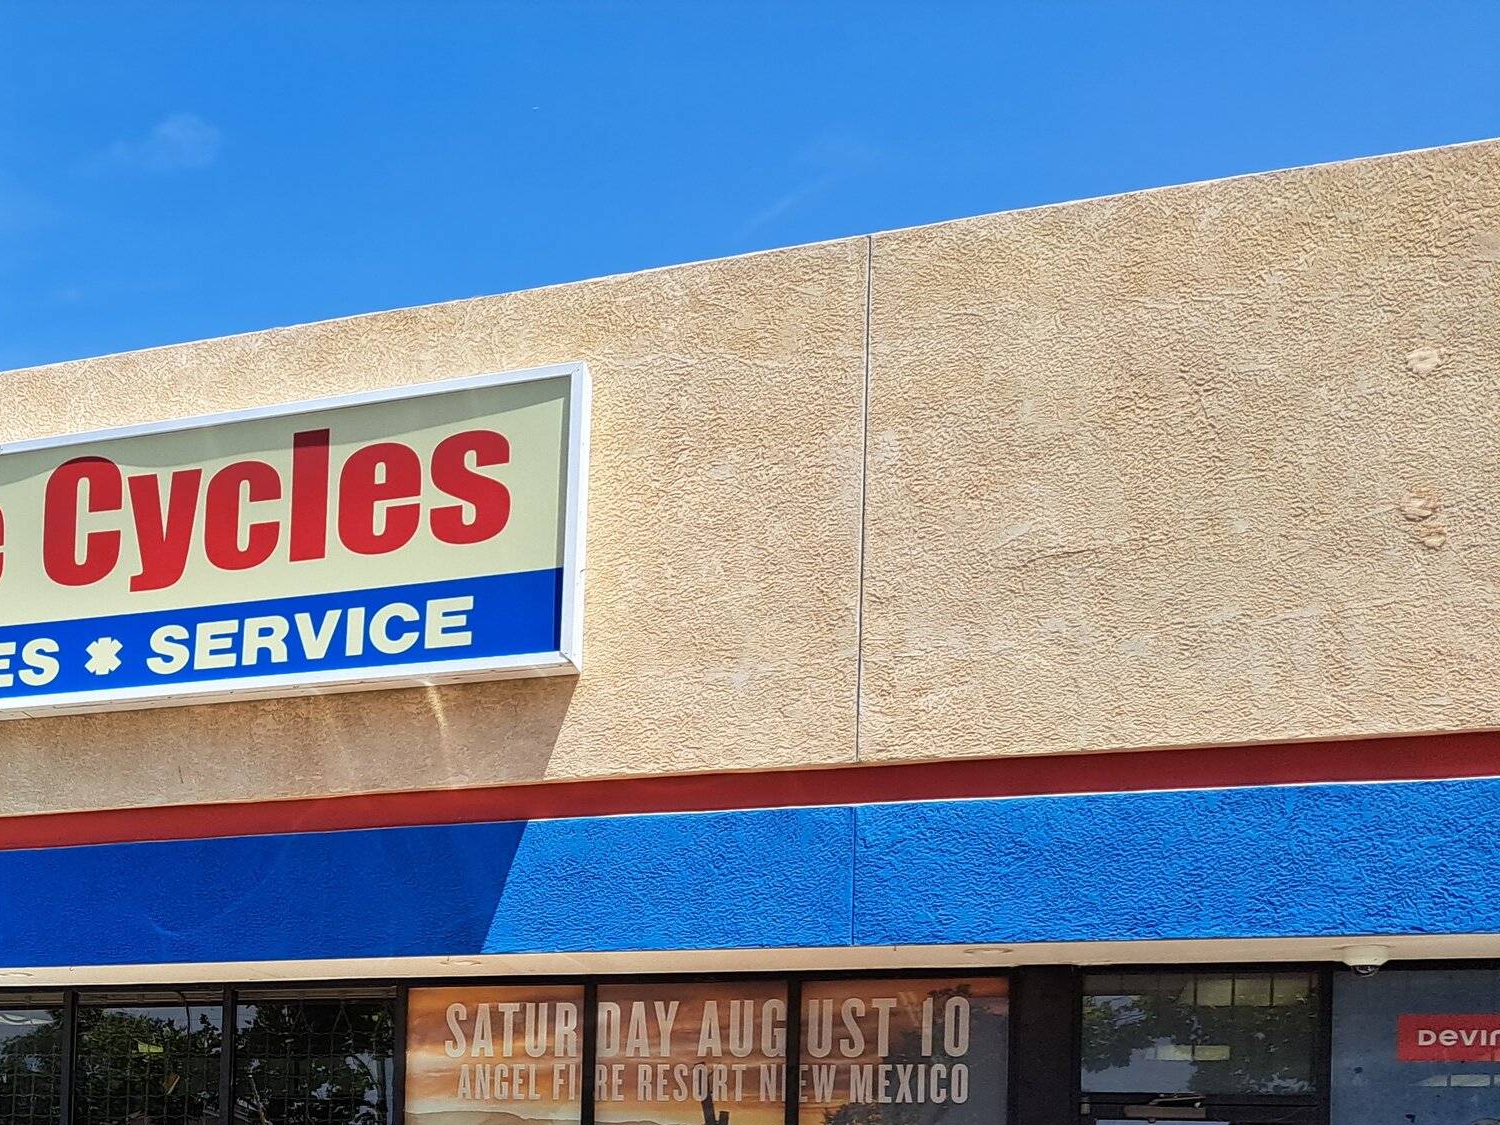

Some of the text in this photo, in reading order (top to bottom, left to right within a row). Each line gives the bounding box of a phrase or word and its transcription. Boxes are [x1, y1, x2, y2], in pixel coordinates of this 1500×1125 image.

[42, 428, 512, 592] Cycles
[146, 596, 475, 676] SERVICE
[444, 996, 971, 1059] SATURDAY AUGUST 10
[456, 1063, 970, 1104] ANGEL FIRE RESORT NEW MEXICO
